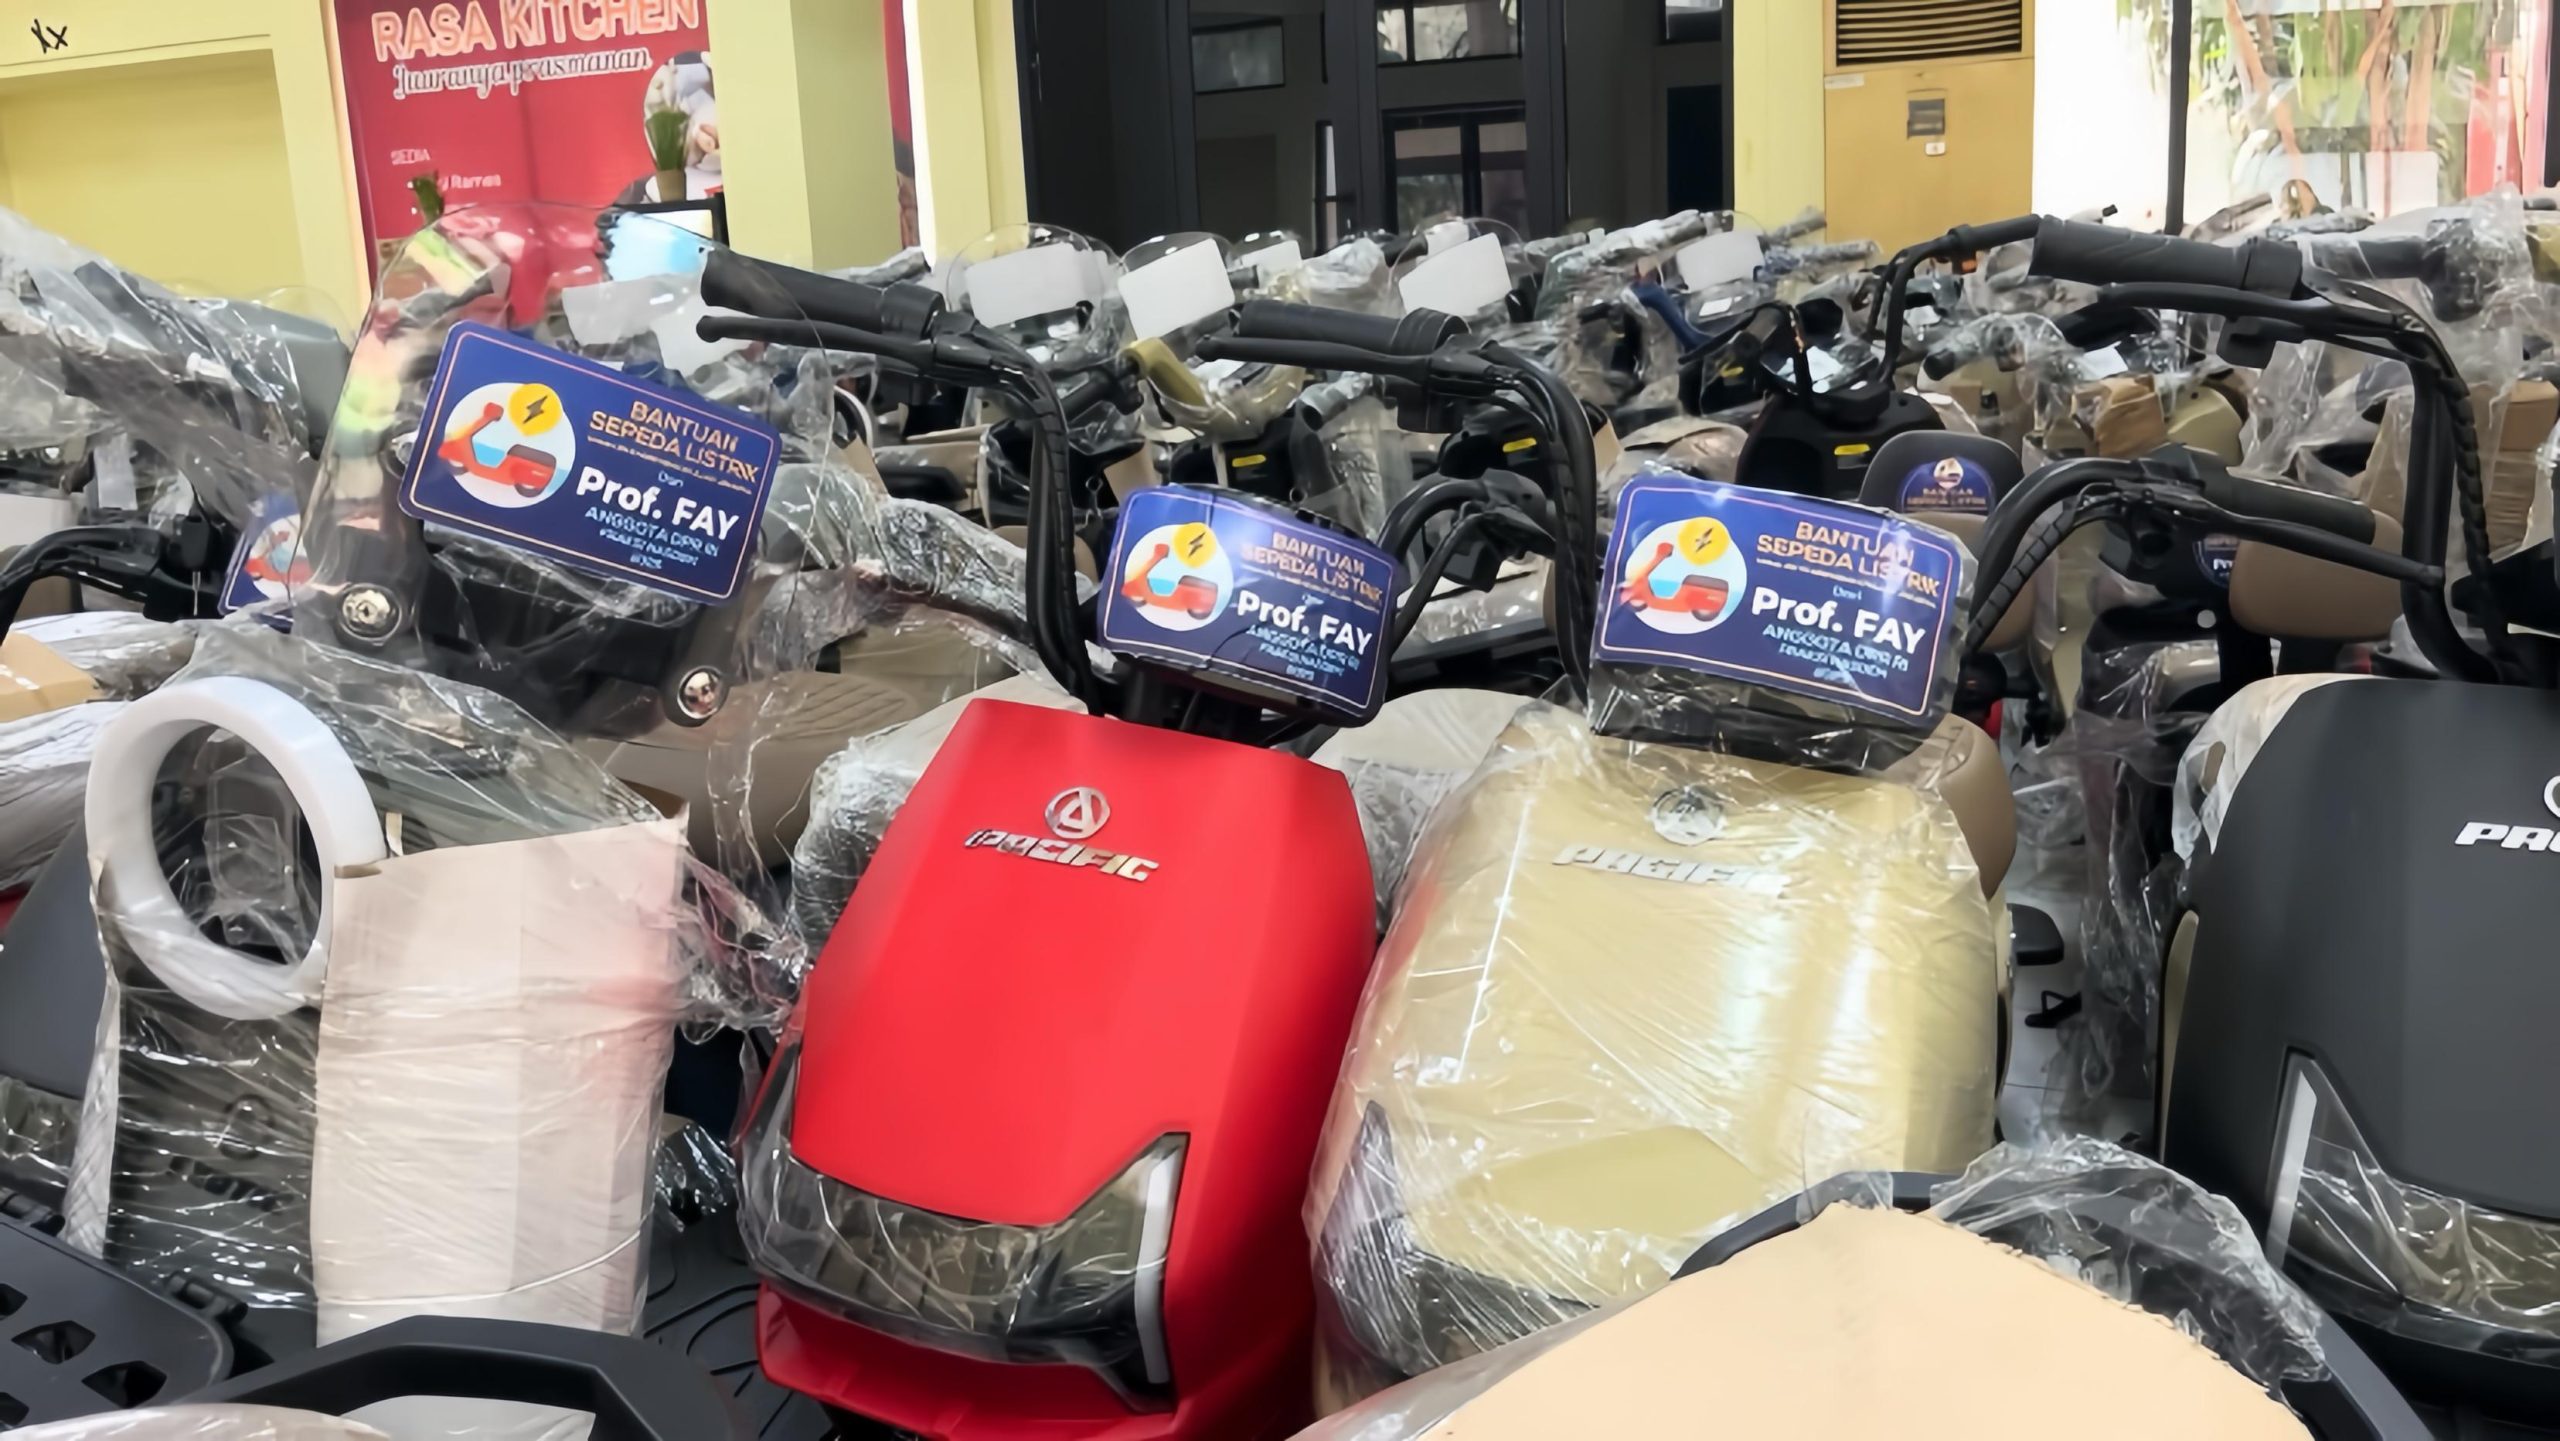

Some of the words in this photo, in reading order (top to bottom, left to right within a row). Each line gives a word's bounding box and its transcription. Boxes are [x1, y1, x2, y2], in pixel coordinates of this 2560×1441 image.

[371, 0, 497, 62] RASA
[500, 0, 700, 49] KITCHEN
[589, 410, 681, 458] SEPEDA
[630, 400, 740, 453] BANTUAN
[576, 465, 662, 520] Prof.
[671, 496, 740, 541] FAY
[1241, 542, 1319, 580] SEPEDA
[1273, 531, 1366, 577] BANTUAN
[1756, 534, 1853, 571] SEPEDA
[1858, 557, 1941, 598] LISRIK
[1795, 520, 1915, 568] BANTUAN
[1237, 589, 1311, 635] Prof.
[1319, 614, 1373, 656] FAY
[1751, 586, 1844, 633] Prof.
[1853, 608, 1926, 655] FAY
[964, 828, 1160, 882] PACIFIC
[2454, 821, 2560, 853] PA
